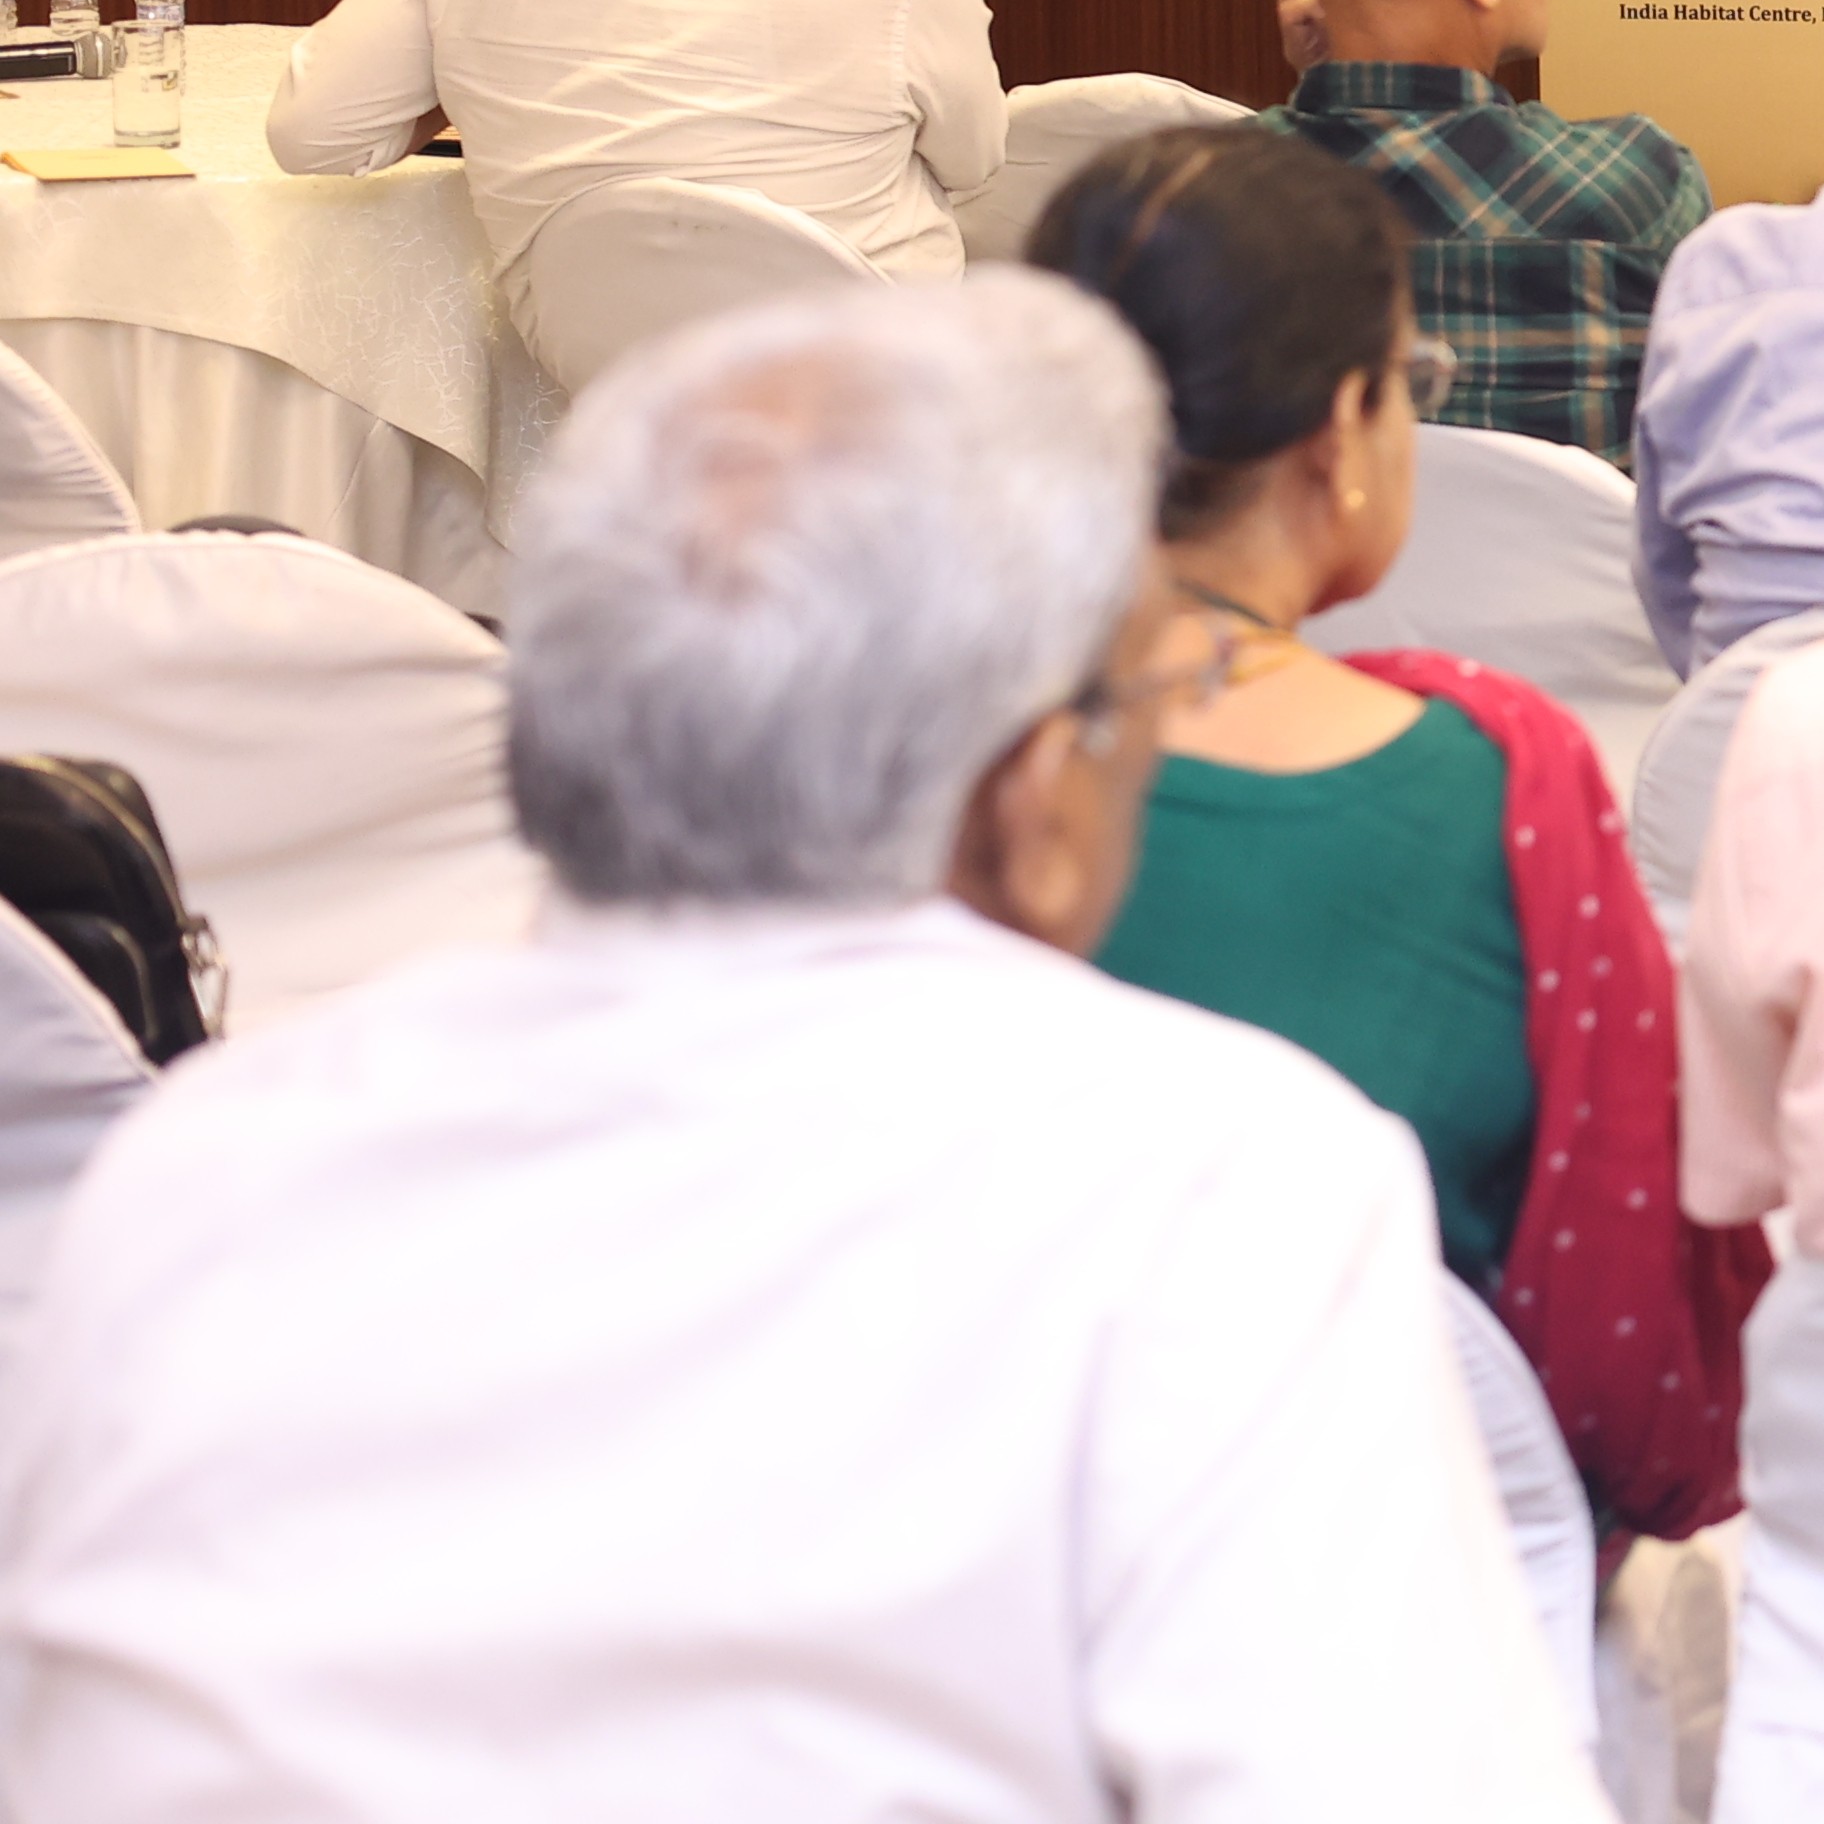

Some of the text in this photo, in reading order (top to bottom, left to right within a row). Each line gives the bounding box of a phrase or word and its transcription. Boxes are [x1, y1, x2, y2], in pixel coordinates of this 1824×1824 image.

[1620, 4, 1668, 19] India
[1674, 5, 1744, 20] Habitat
[1750, 6, 1816, 24] Centre,
